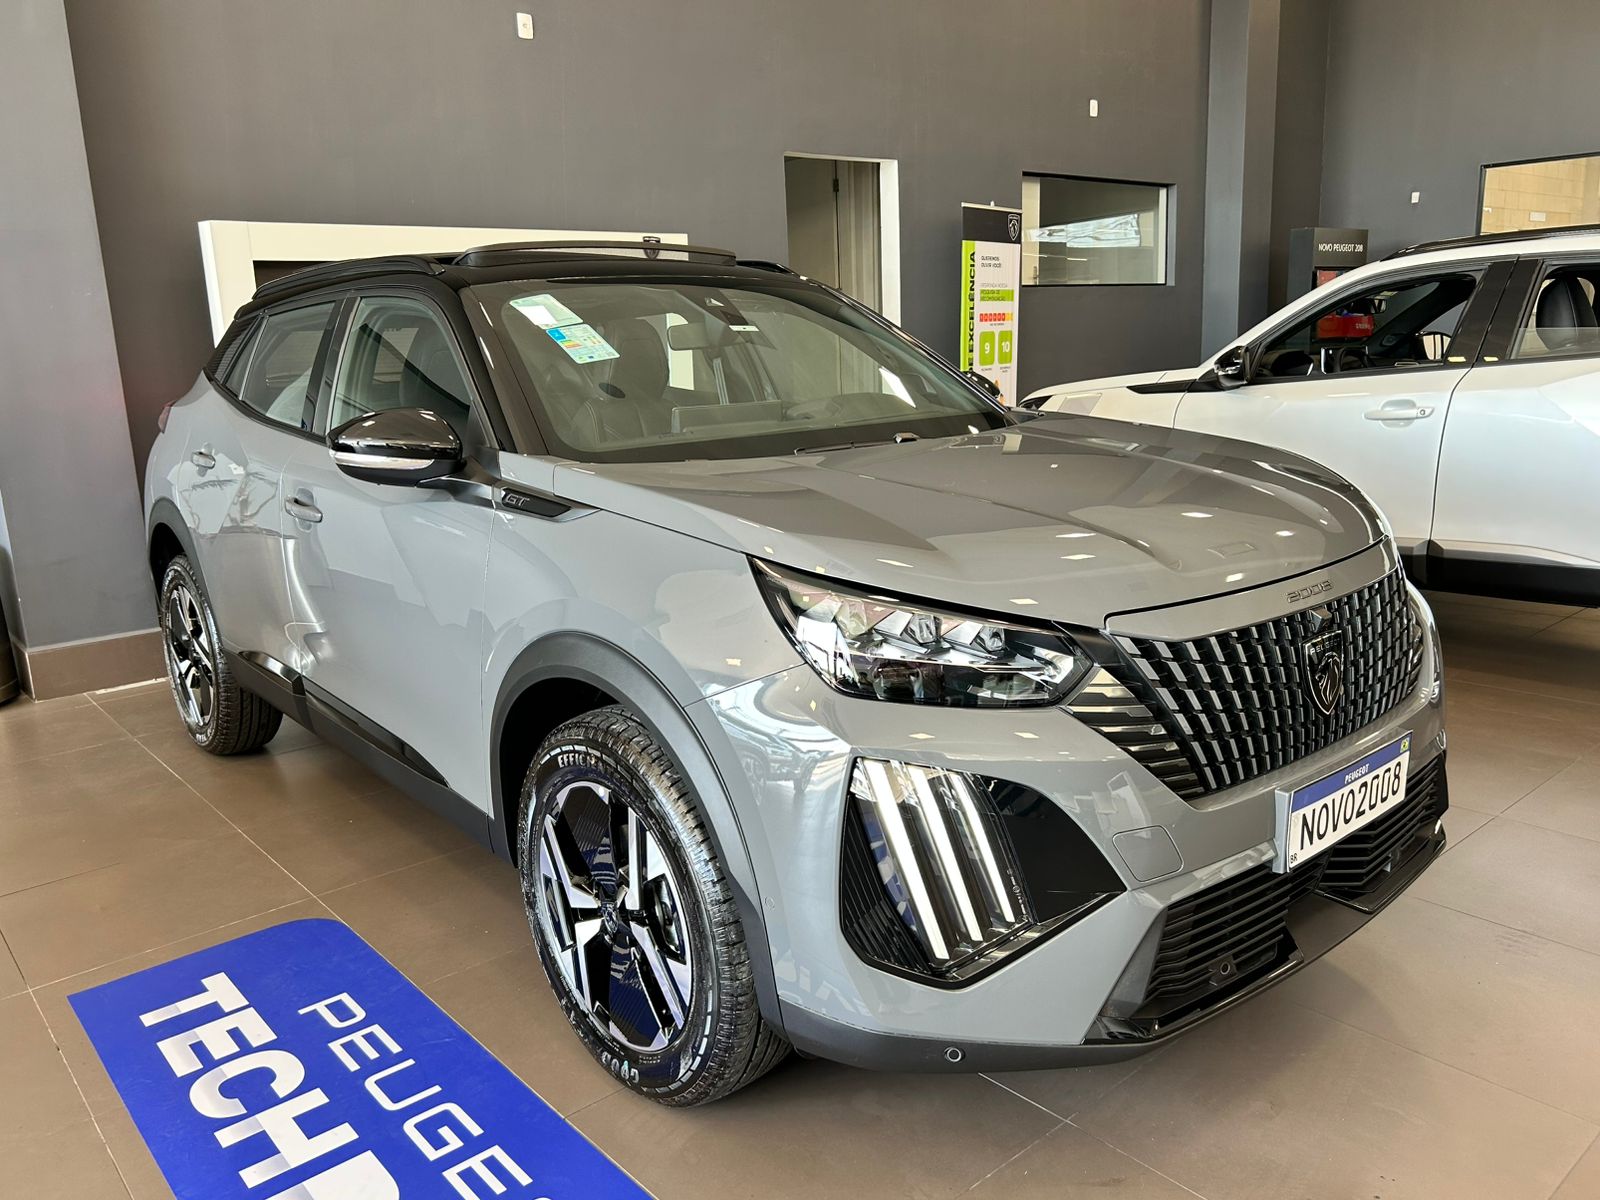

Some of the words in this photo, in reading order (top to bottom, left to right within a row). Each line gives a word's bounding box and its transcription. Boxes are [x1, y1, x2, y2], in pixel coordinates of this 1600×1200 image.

[1319, 243, 1332, 252] NOVO
[1333, 244, 1354, 252] PEUGEOT
[1355, 244, 1363, 252] 208
[968, 251, 976, 353] EXCELÊNCIA
[985, 343, 990, 354] 9
[1002, 342, 1010, 352] 10
[506, 493, 530, 507] GT
[1286, 580, 1333, 604] 2008
[1344, 763, 1370, 784] PEUGEOT
[1300, 760, 1402, 851] NOVO2008
[1290, 852, 1298, 864] BR
[297, 992, 555, 1200] PEUGE
